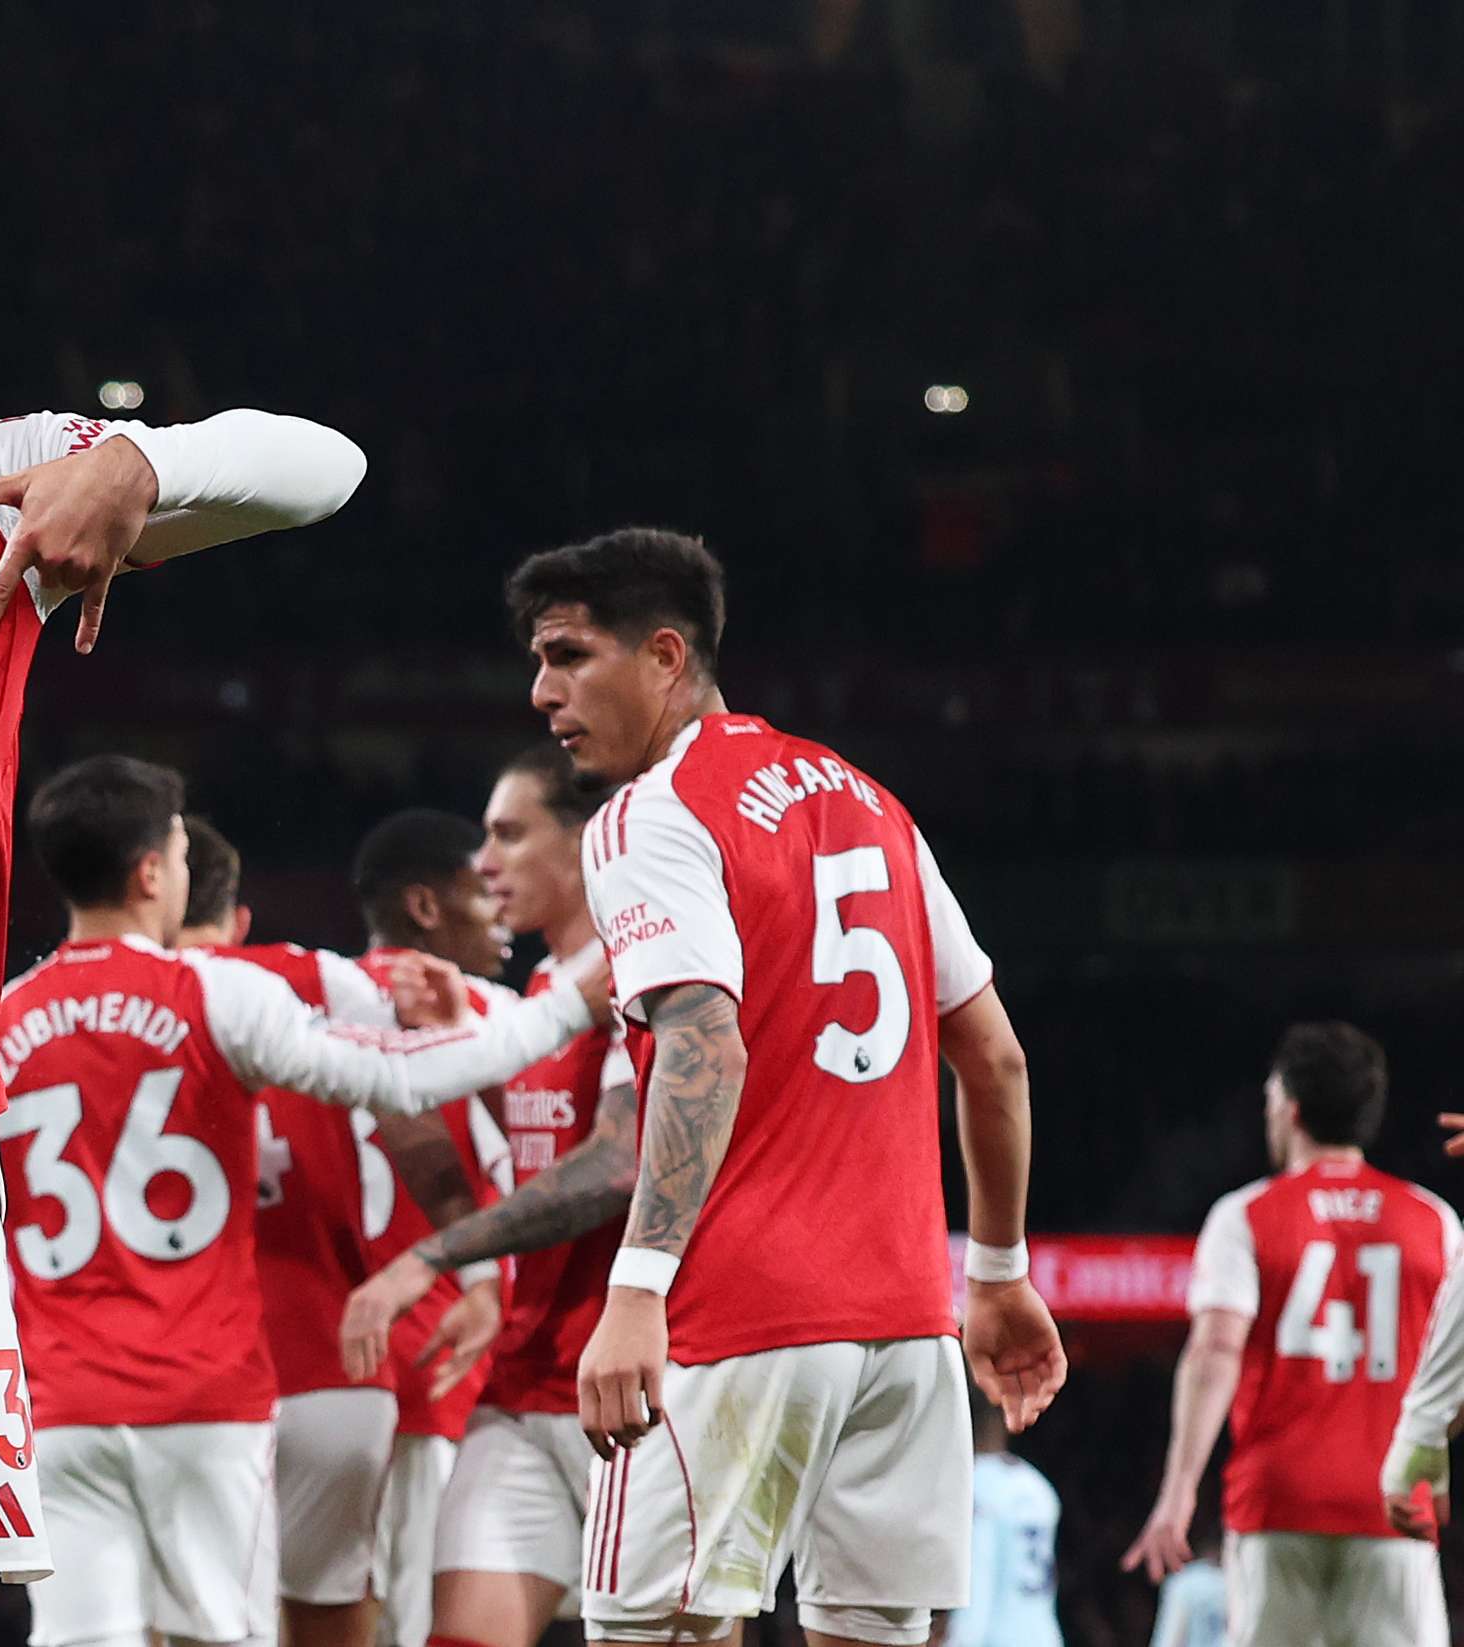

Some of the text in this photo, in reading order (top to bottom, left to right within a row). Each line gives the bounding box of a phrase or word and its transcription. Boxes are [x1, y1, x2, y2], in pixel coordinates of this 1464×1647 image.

[736, 756, 884, 834] HINCAPIE
[609, 917, 677, 958] ANDA
[812, 846, 911, 1083] 5
[1277, 1241, 1402, 1383] 41
